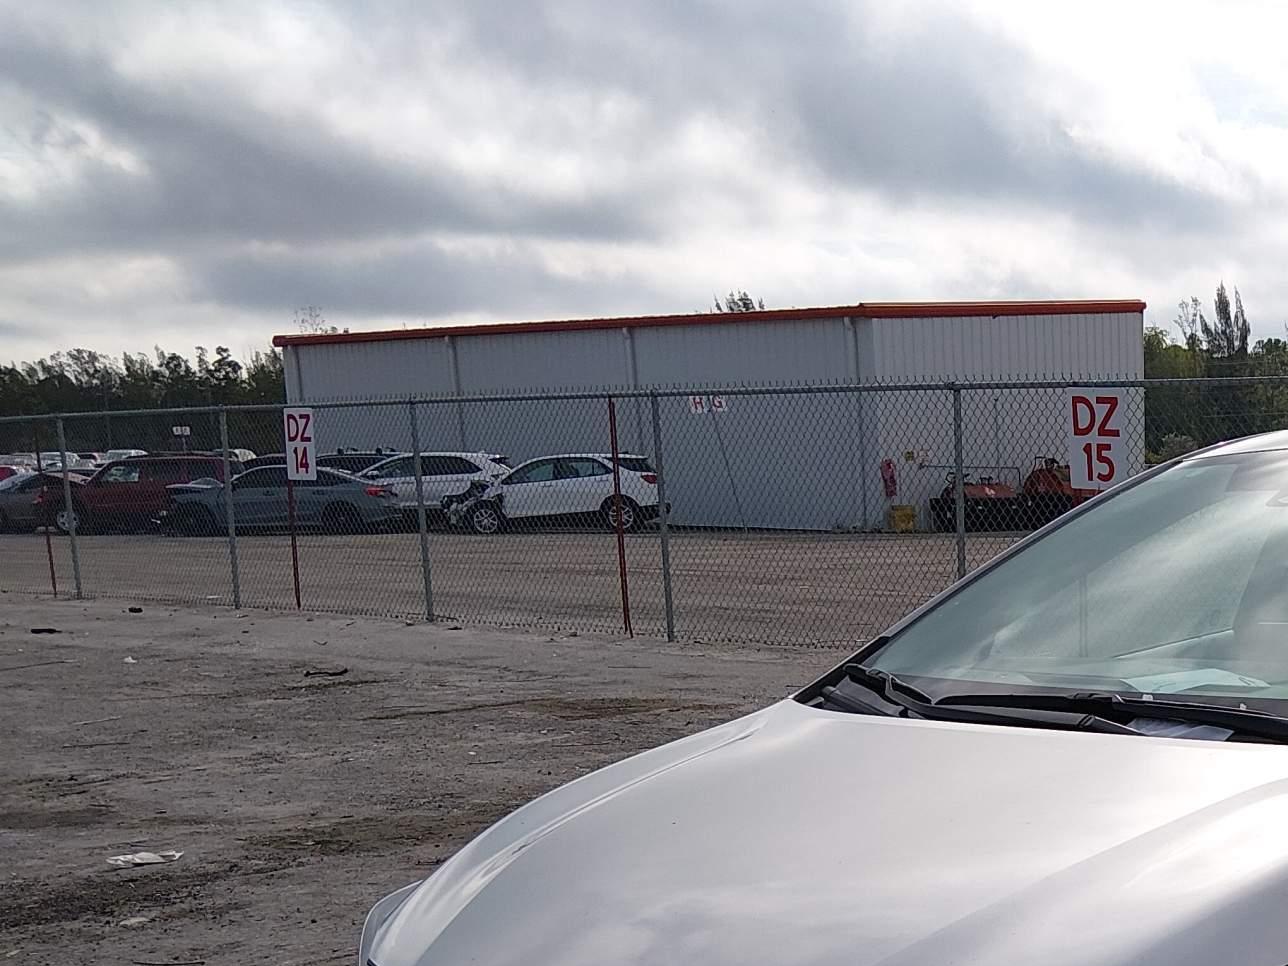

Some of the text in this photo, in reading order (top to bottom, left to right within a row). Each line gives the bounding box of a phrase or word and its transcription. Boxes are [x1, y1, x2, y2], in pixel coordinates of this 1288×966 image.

[287, 413, 312, 443] DZ
[1071, 395, 1121, 437] DZ
[293, 446, 310, 475] 14
[1082, 442, 1115, 482] 15
